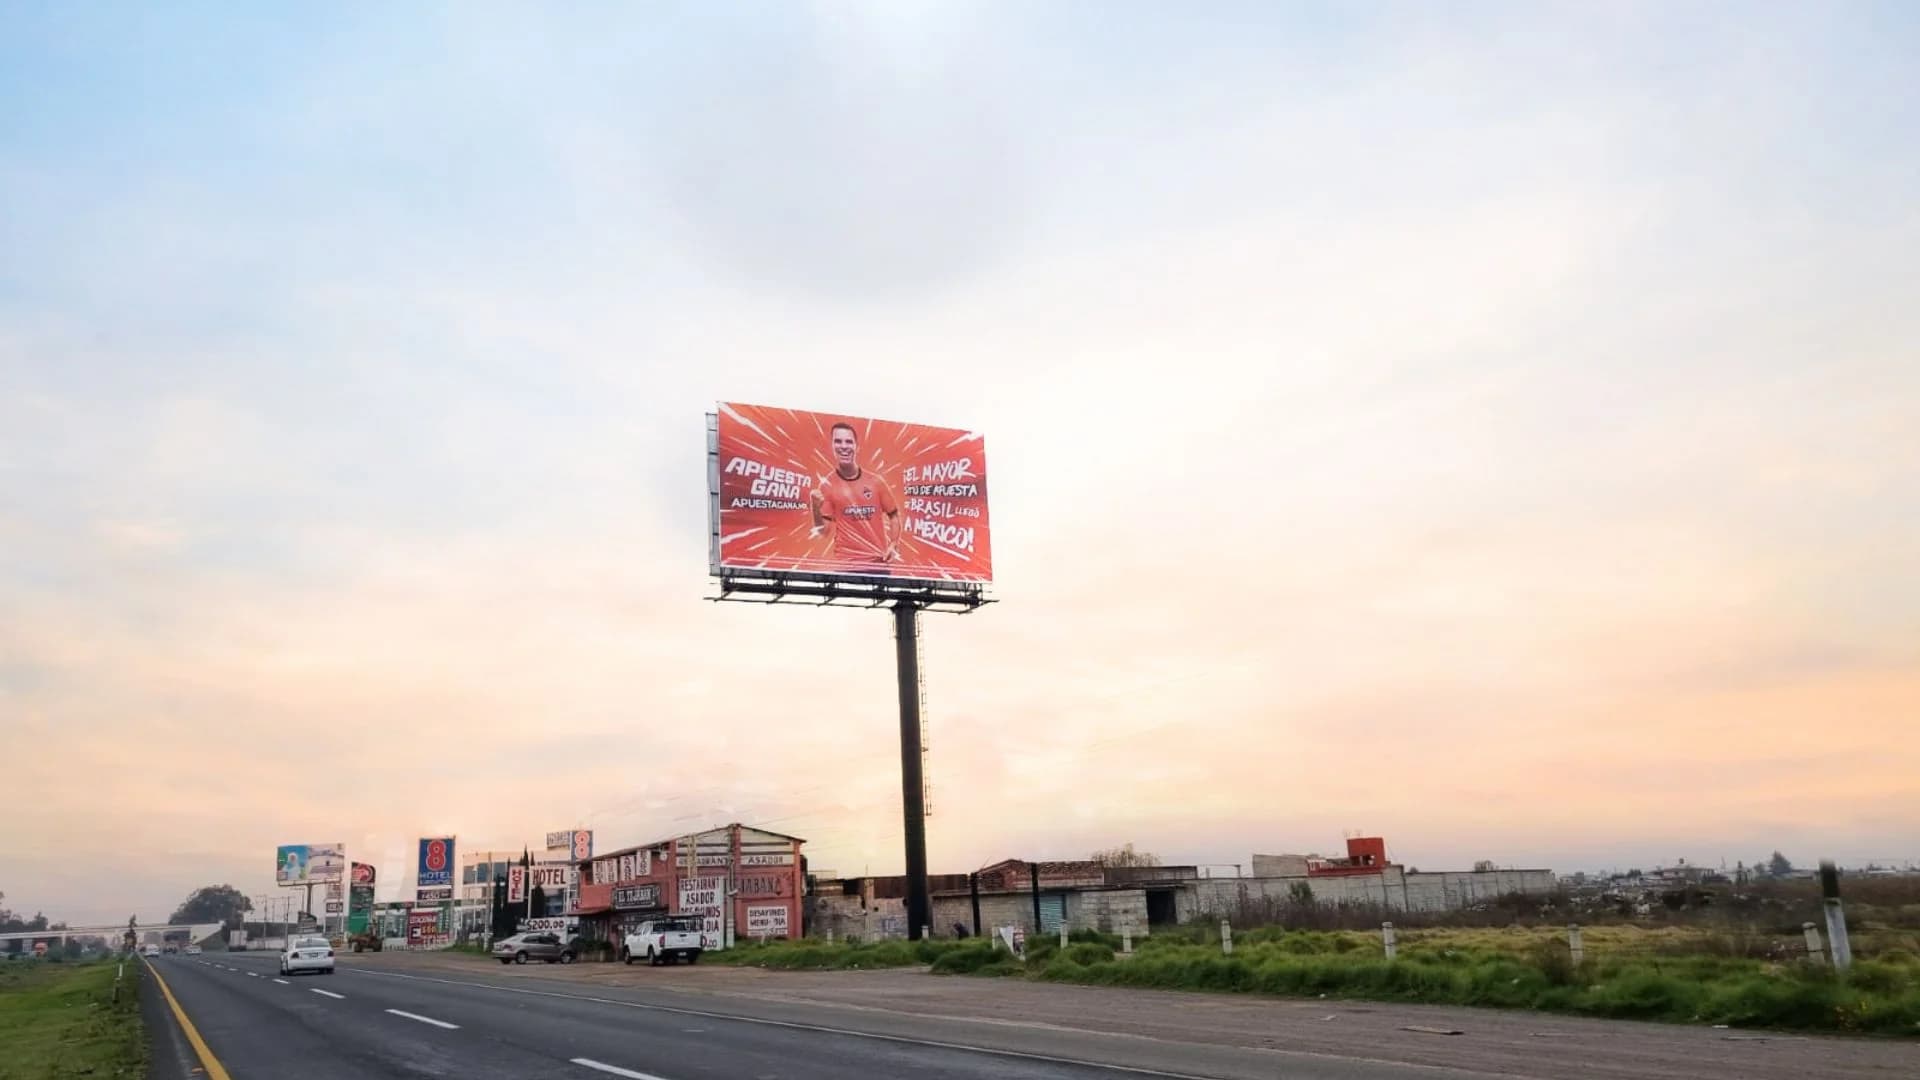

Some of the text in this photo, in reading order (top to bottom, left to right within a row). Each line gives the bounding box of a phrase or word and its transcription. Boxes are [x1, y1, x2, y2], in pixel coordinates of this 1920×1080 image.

[725, 457, 812, 488] APUESTA
[922, 458, 977, 481] MAYOR
[751, 479, 801, 499] GANA
[920, 485, 932, 495] DE
[933, 484, 978, 497] APUESTA
[911, 498, 955, 518] BRASIL
[904, 515, 974, 552] A MÉXICO!
[575, 831, 590, 859] 8
[426, 840, 446, 871] 8
[748, 855, 784, 865] ASADOR
[419, 871, 451, 881] HOTEL
[532, 868, 567, 886] HOTEL
[686, 891, 716, 905] ASADOR
[527, 919, 565, 931] $200.00
[706, 920, 720, 933] DIA
